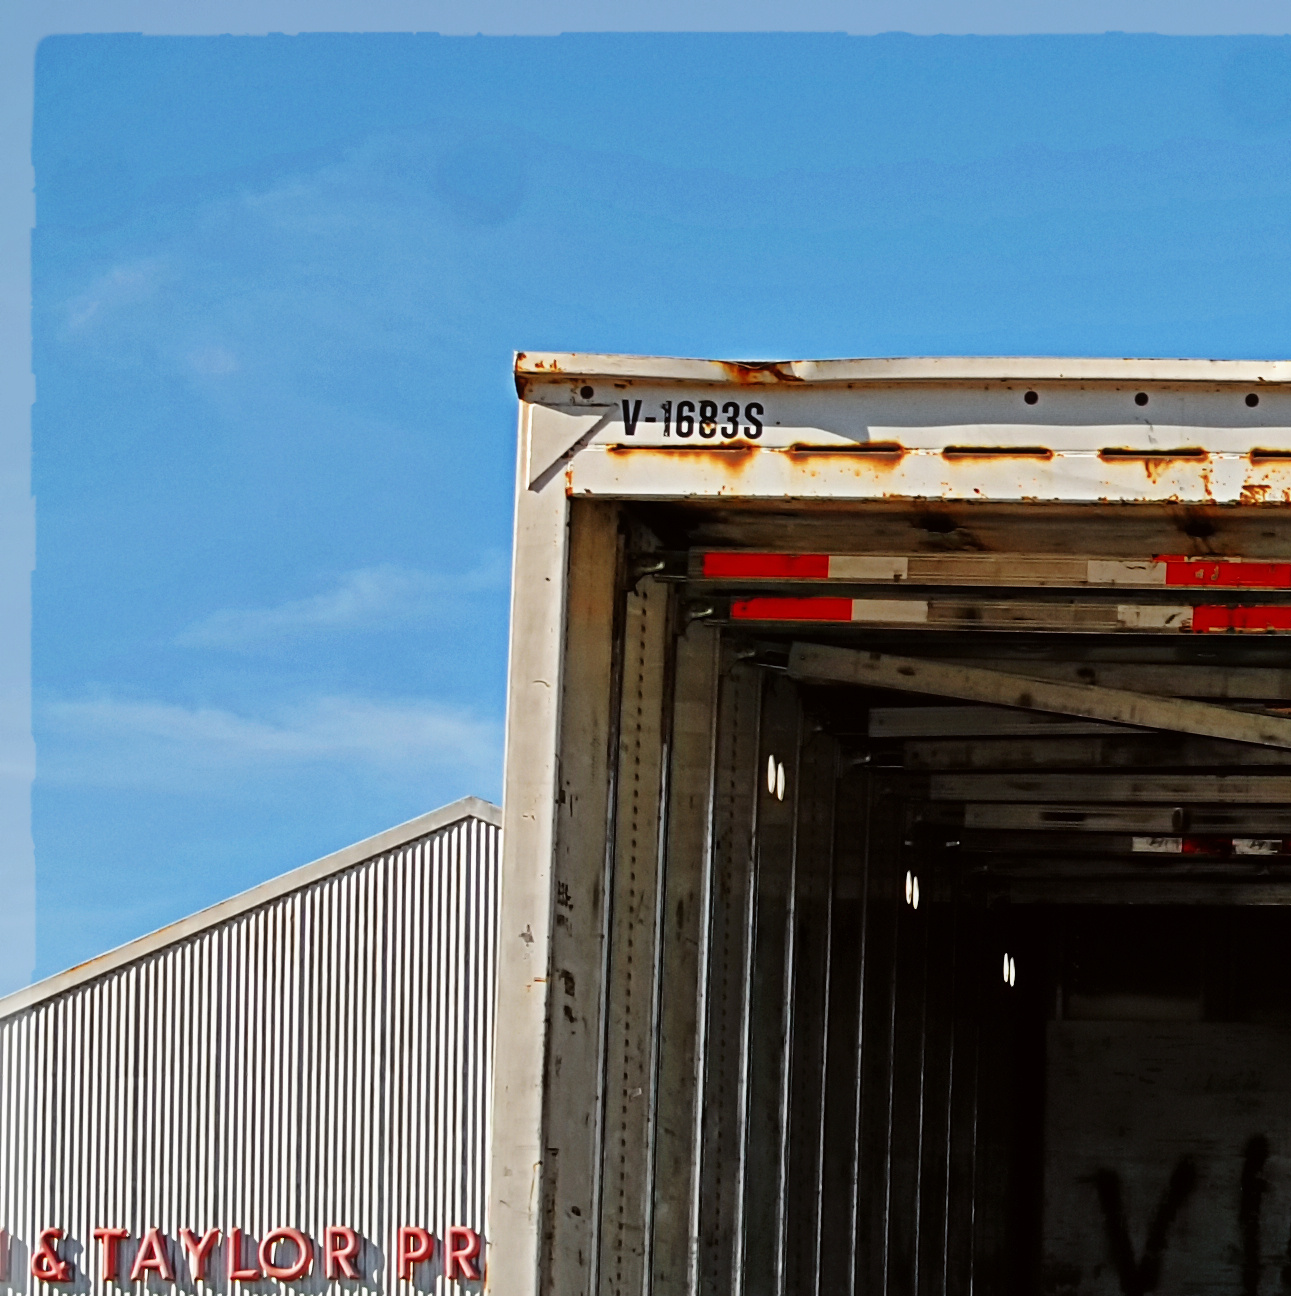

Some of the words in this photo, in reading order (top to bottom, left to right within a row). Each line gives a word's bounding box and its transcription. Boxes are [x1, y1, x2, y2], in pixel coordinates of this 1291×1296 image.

[622, 399, 764, 439] V-1683S
[31, 1225, 72, 1282] &
[94, 1225, 360, 1282] TAYLOR
